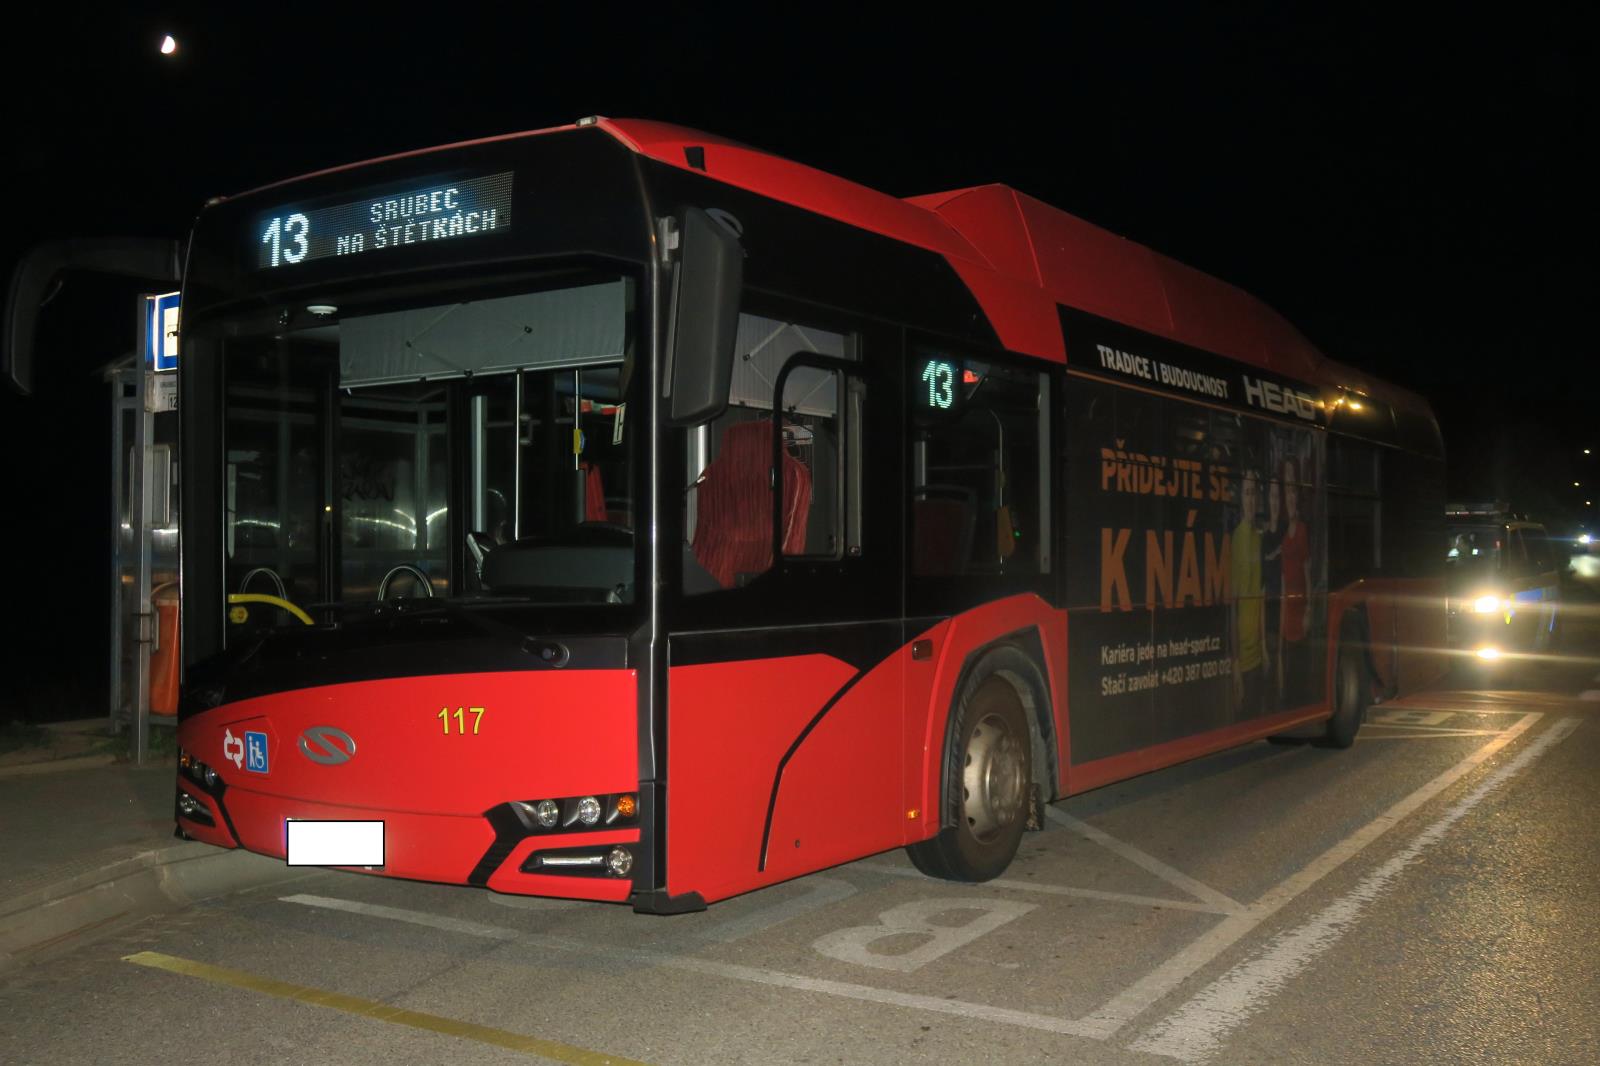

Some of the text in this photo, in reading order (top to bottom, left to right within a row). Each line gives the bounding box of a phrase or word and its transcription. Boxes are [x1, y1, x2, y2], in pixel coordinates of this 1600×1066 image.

[262, 213, 310, 267] 13
[336, 233, 364, 256] NA
[922, 360, 953, 409] 13
[1096, 343, 1152, 380] TRADICE
[1160, 362, 1229, 399] BUDOUCNOST
[1100, 437, 1204, 500] PŘIDEJTE
[1100, 509, 1233, 613] K NÁM
[438, 706, 485, 735] 117
